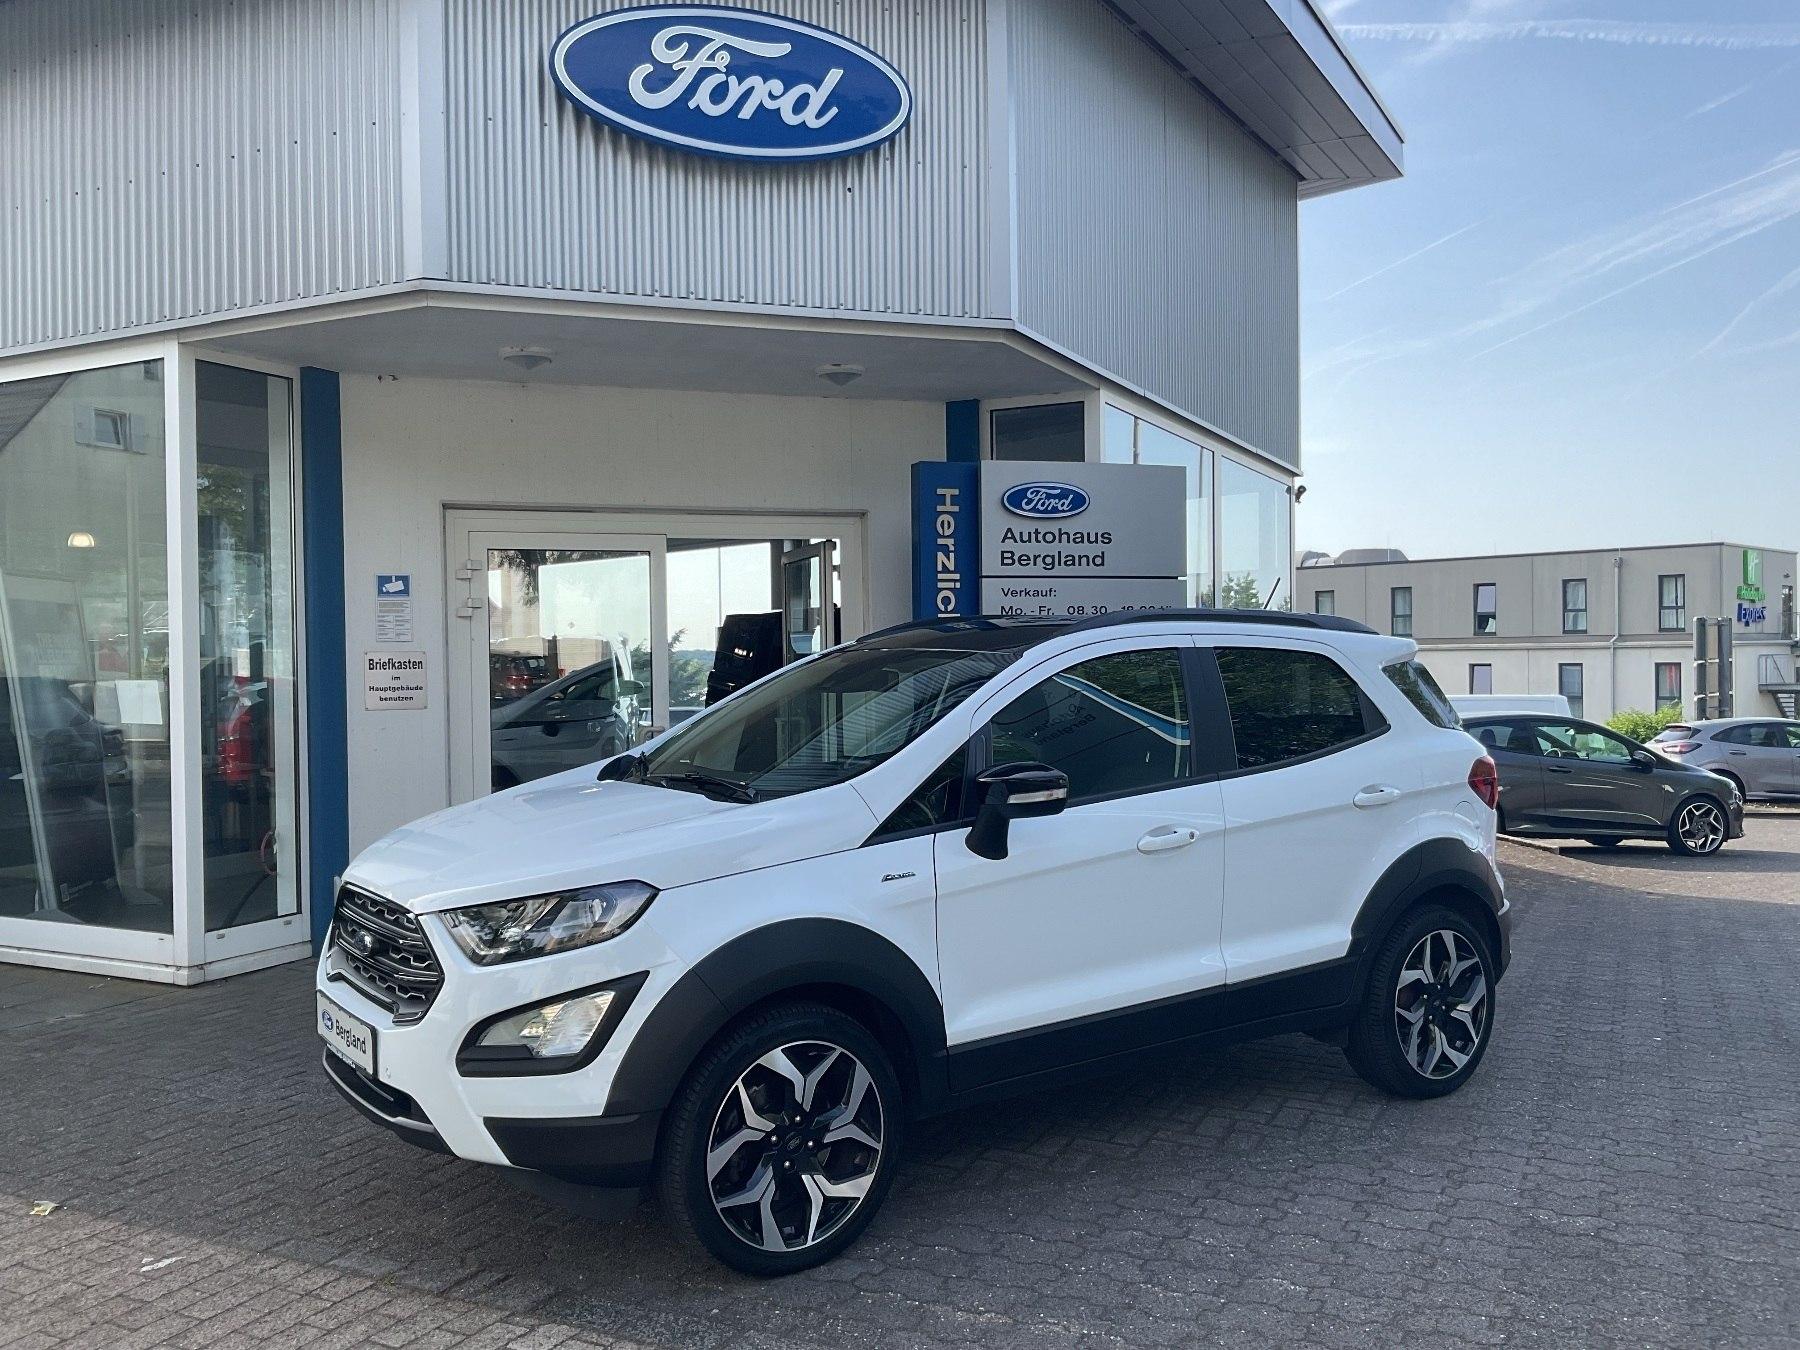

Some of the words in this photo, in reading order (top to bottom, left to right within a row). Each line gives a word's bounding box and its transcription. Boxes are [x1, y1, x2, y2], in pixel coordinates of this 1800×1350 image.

[628, 25, 844, 129] Ford
[1021, 486, 1074, 512] Ford
[1000, 527, 1113, 545] Autohaus
[936, 487, 961, 618] Herzlic
[1000, 550, 1106, 571] Bergland
[1000, 587, 1058, 598] Verkauf:
[1000, 605, 1027, 616] Mo.
[1038, 605, 1055, 616] Fr.
[368, 658, 423, 671] Briefkasten
[391, 674, 401, 682] im
[368, 685, 423, 693] Hauptgebäude
[336, 1019, 367, 1055] Bergland
